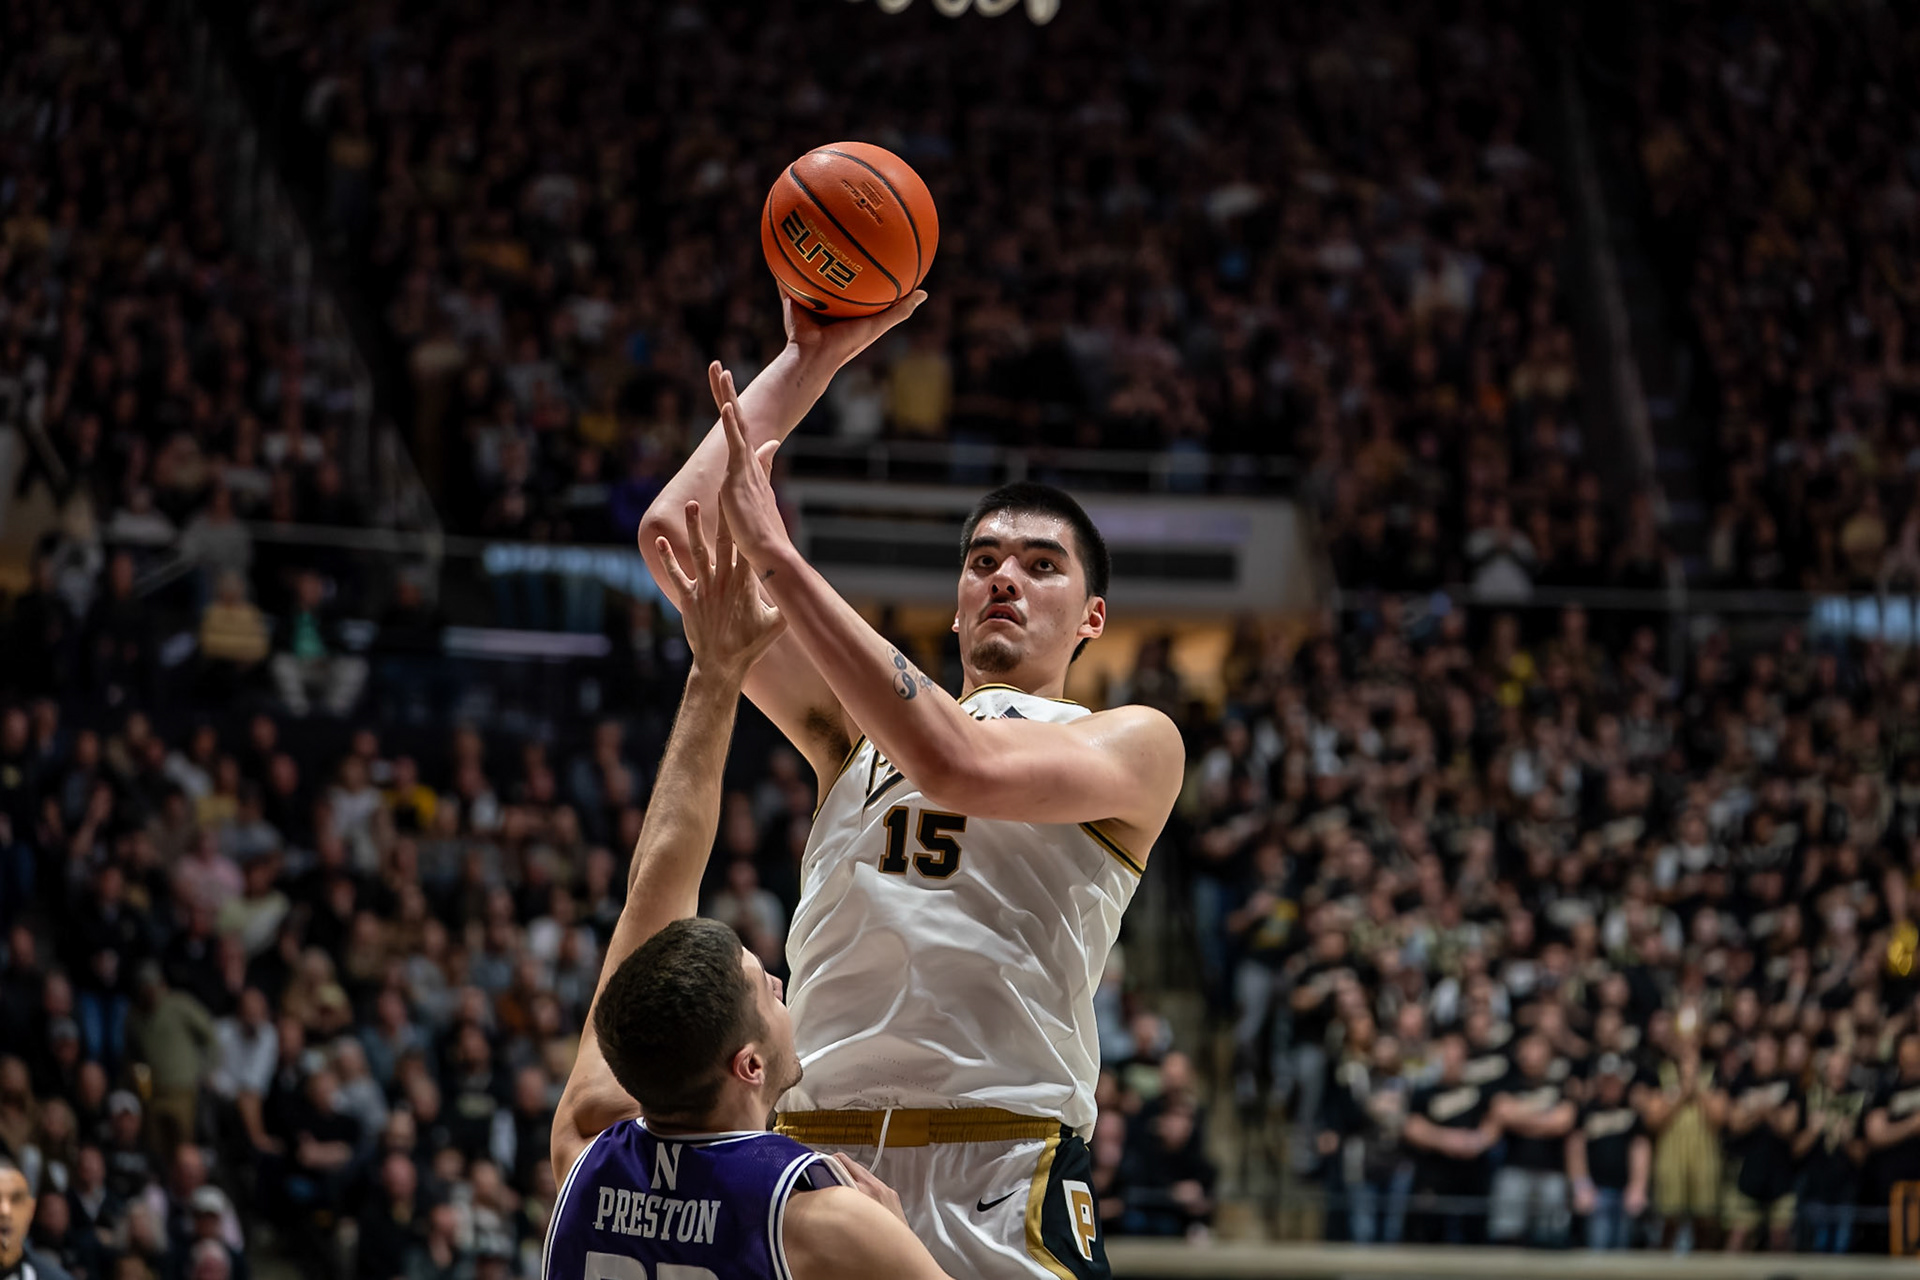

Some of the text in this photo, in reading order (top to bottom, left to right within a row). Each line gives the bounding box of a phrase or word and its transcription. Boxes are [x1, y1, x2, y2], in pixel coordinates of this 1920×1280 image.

[781, 207, 858, 290] ELITE
[878, 805, 967, 880] 15
[651, 1141, 682, 1191] N
[593, 1186, 721, 1245] PRESTON
